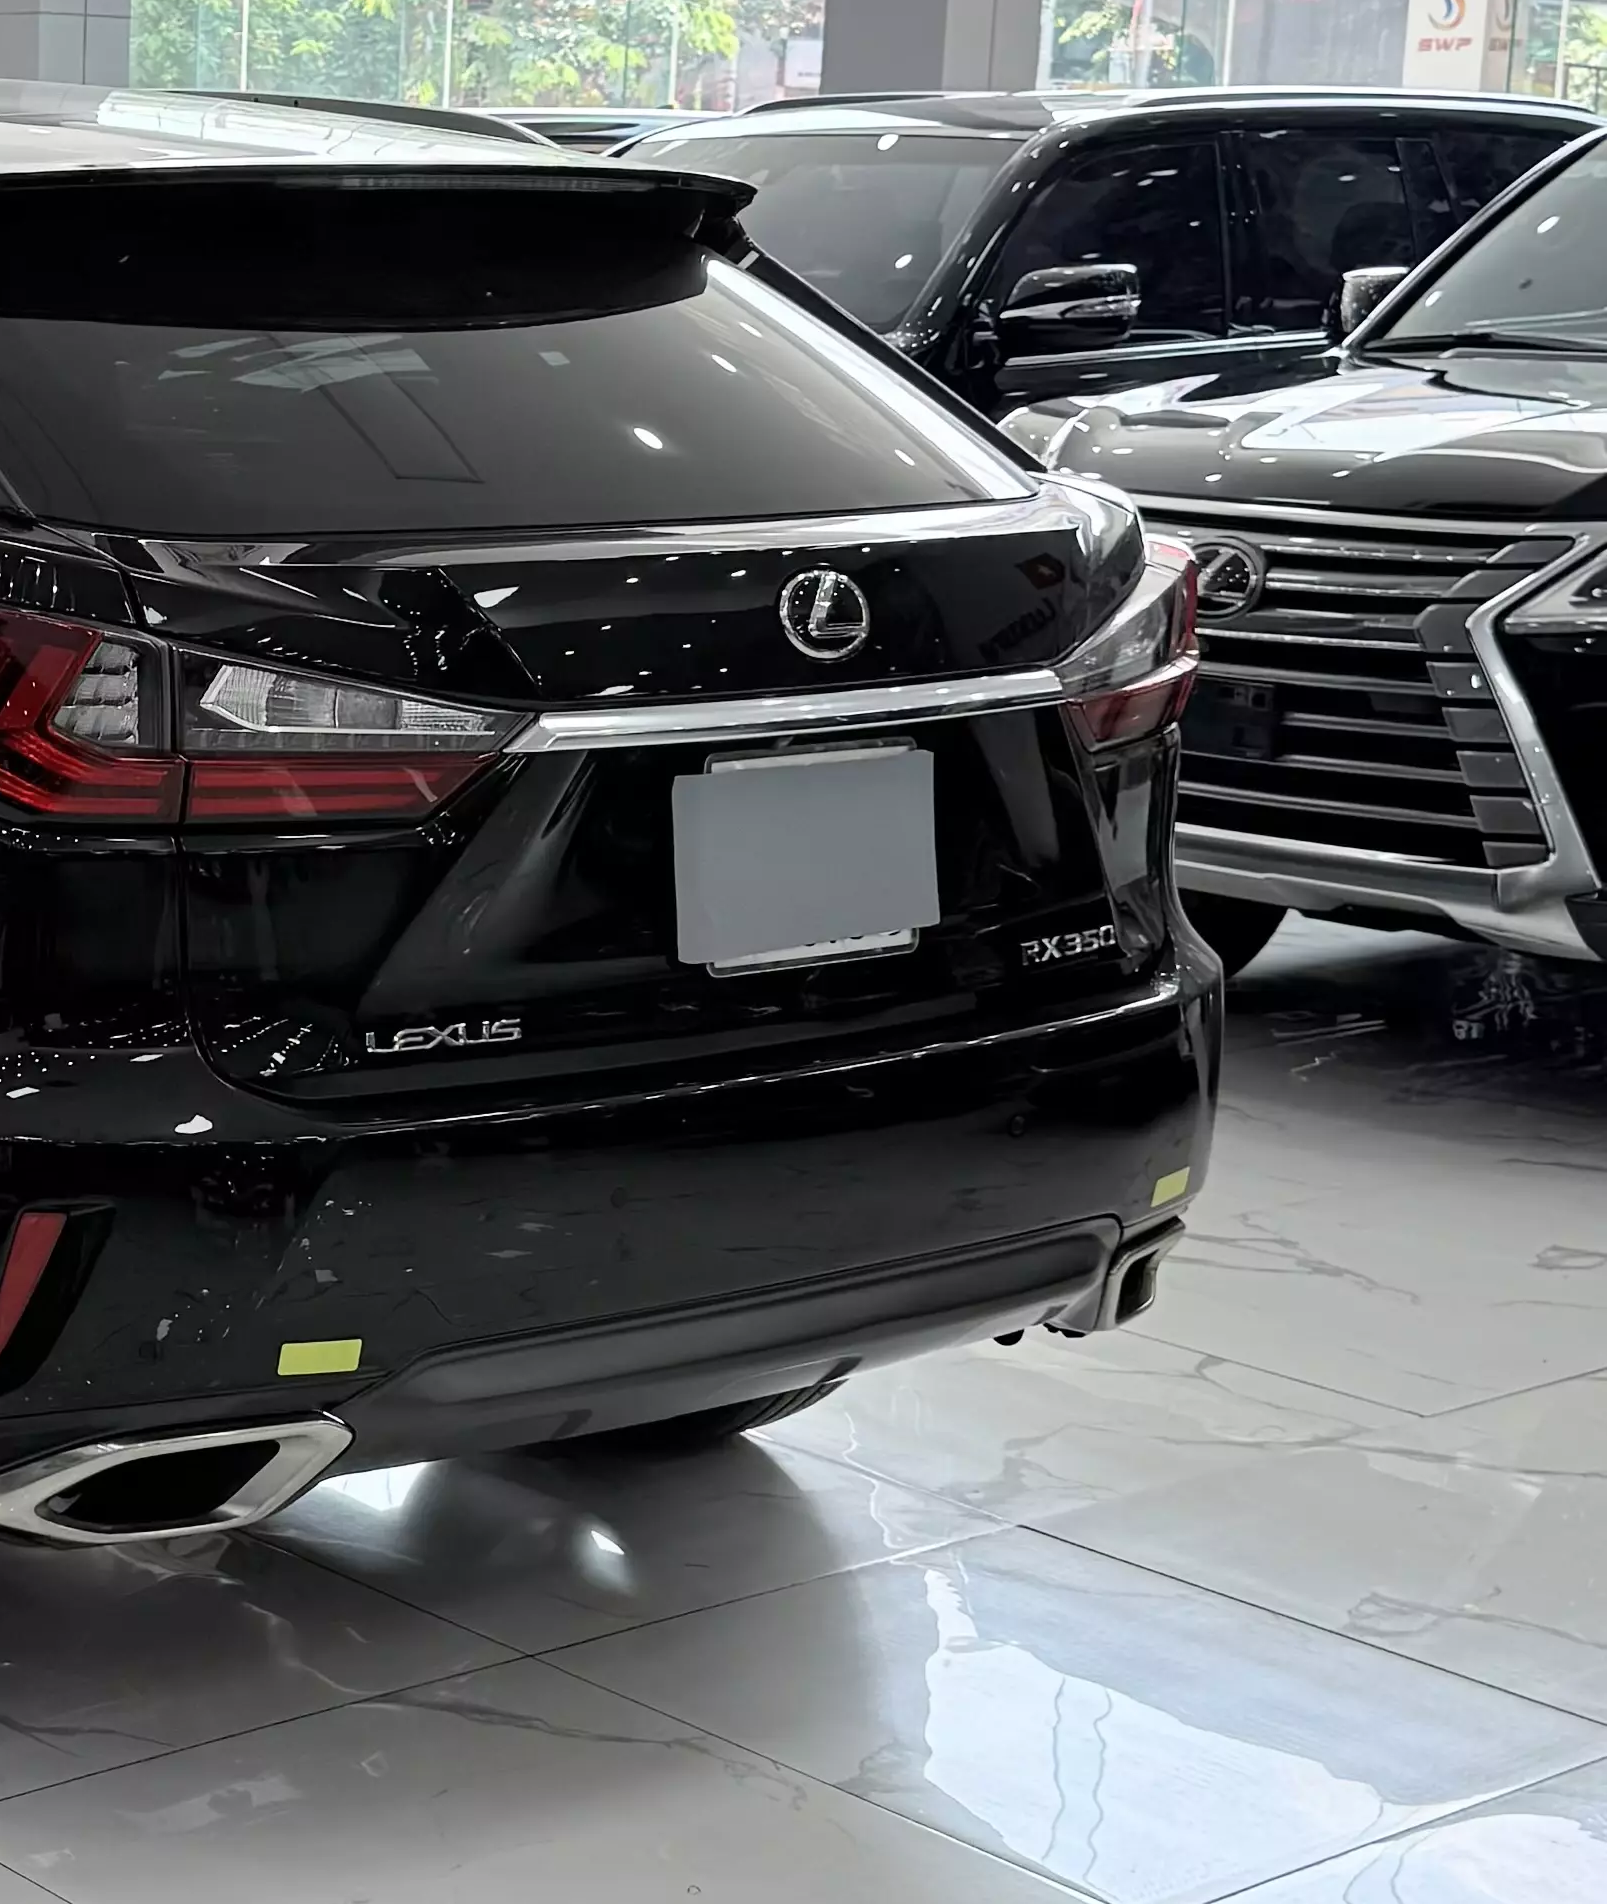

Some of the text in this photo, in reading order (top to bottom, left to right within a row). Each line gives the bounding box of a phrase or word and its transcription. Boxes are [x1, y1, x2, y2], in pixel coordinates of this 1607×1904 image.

[1417, 37, 1473, 52] SWP
[1020, 925, 1116, 966] RX350
[366, 1018, 522, 1053] LEXUS
